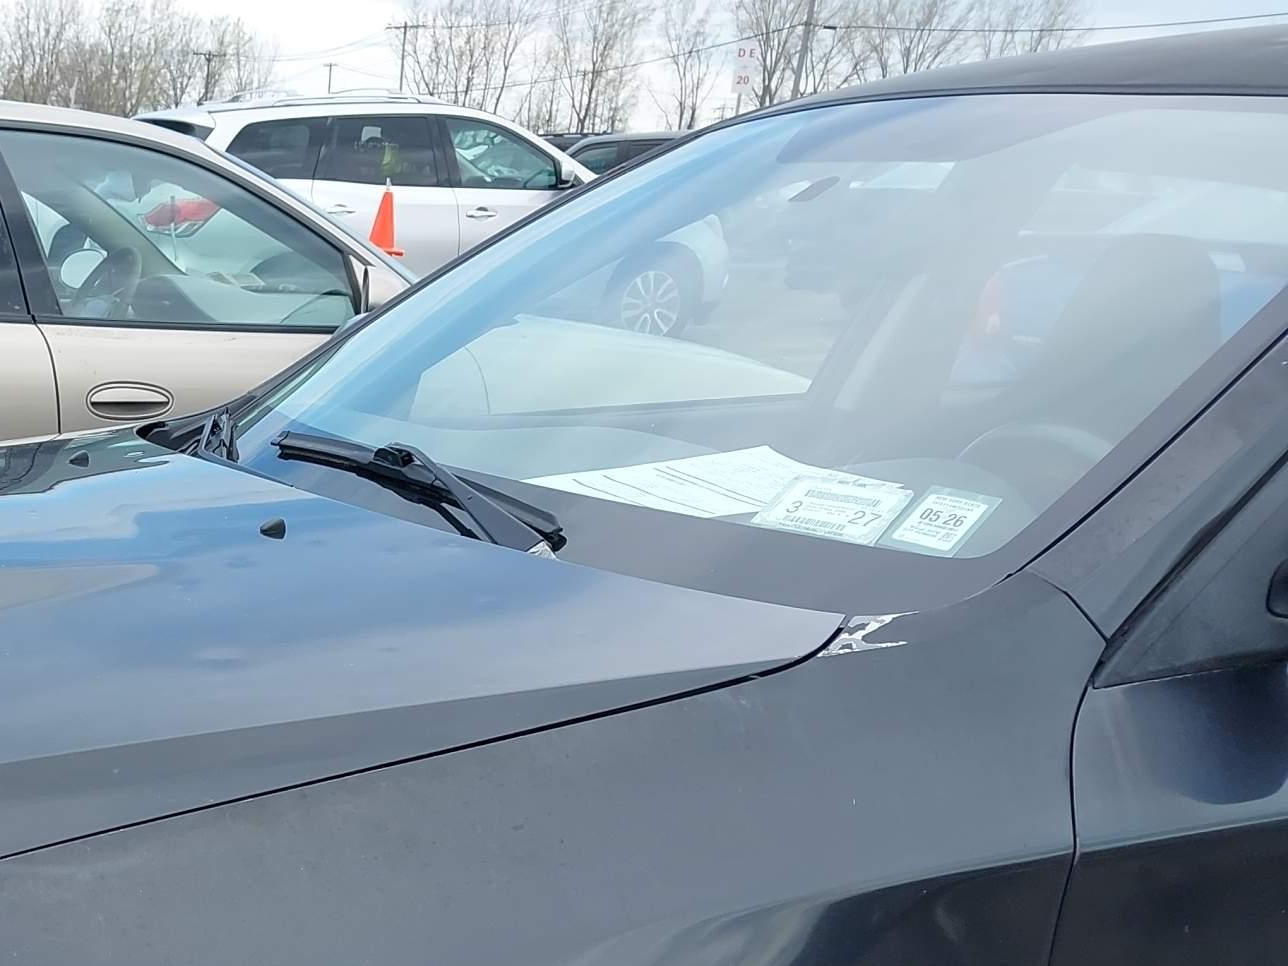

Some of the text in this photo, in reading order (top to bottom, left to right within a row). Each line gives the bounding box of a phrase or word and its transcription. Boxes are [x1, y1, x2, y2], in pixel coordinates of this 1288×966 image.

[738, 48, 757, 58] D E
[735, 75, 750, 85] 20
[786, 500, 803, 513] 3
[847, 510, 882, 527] 27
[919, 507, 944, 522] 05
[942, 513, 967, 528] 26
